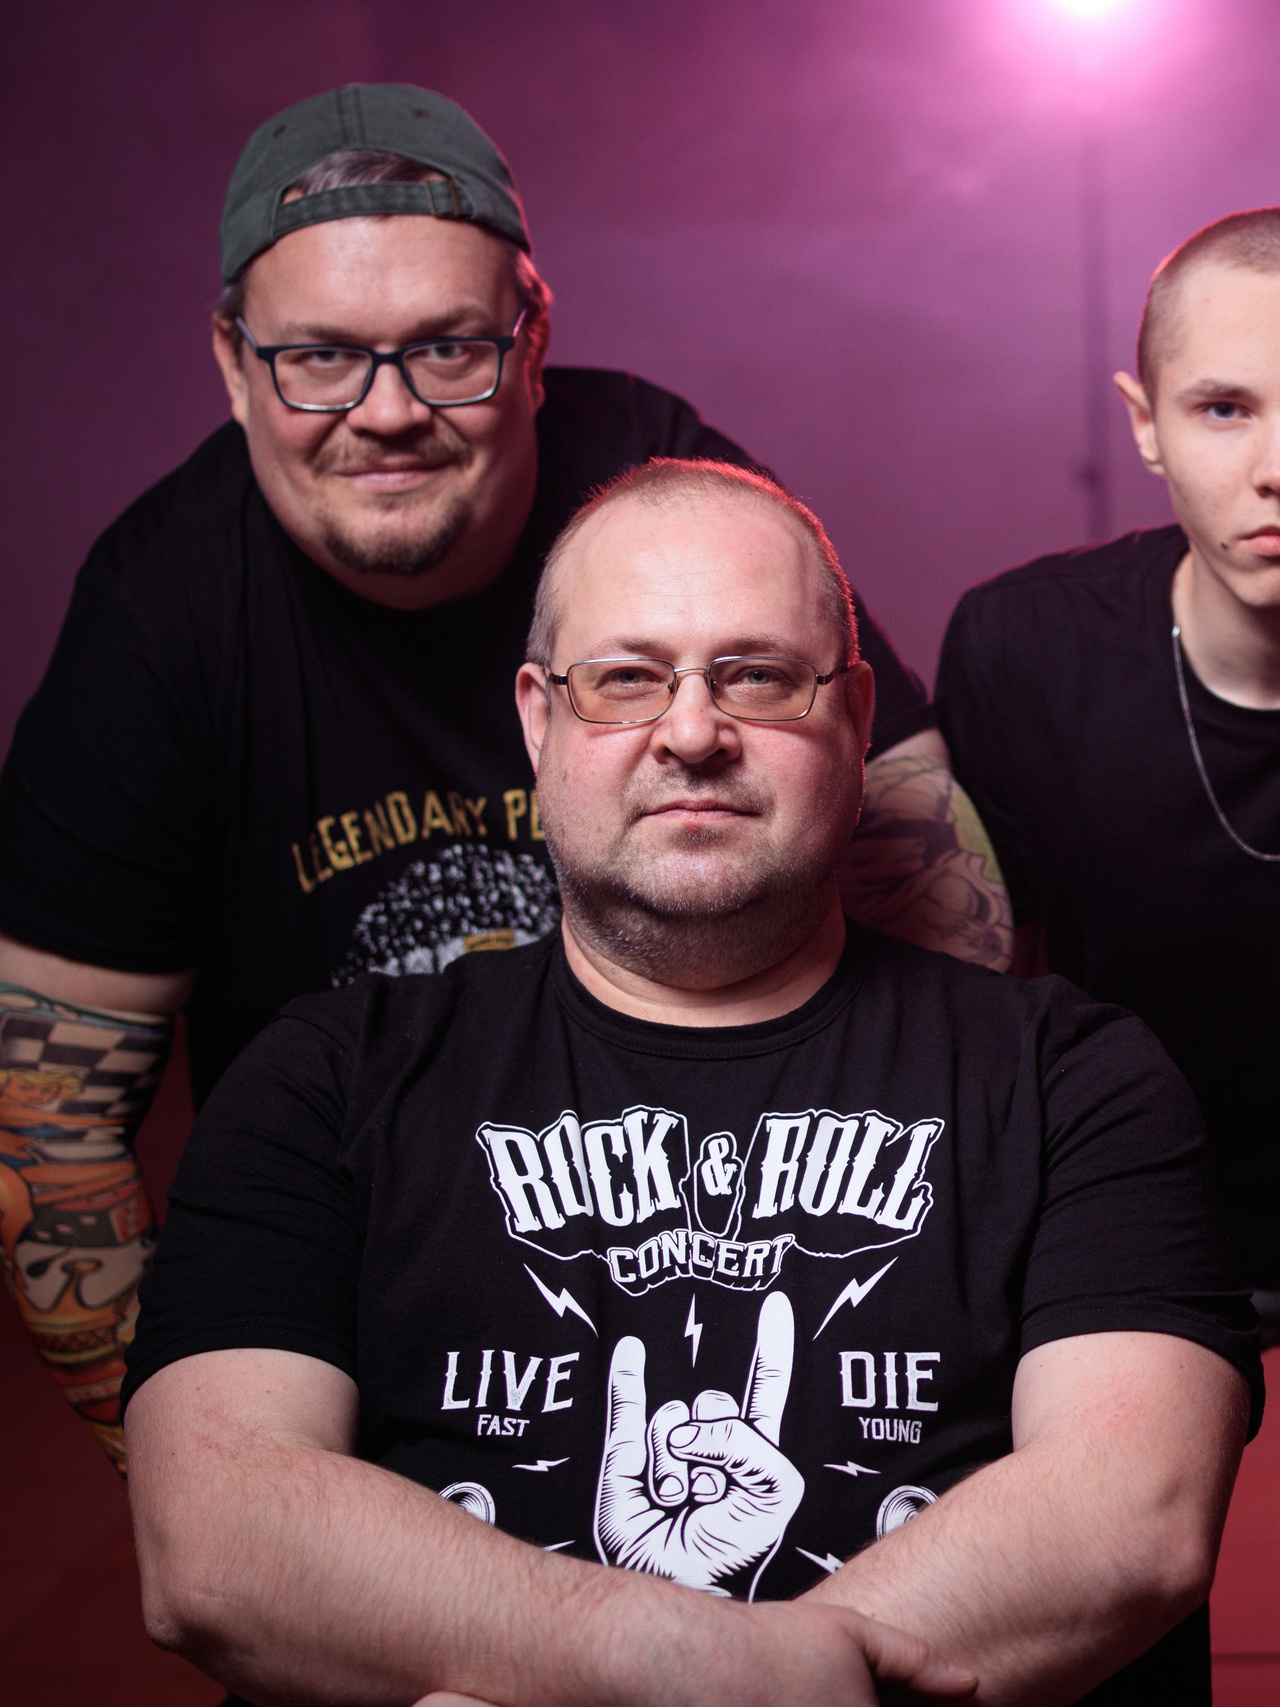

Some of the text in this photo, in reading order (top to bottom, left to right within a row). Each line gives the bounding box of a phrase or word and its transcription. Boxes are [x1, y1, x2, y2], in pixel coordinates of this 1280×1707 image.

[291, 790, 487, 894] LEGENDARY
[482, 1110, 940, 1234] ROCK & ROLL
[609, 1232, 789, 1283] CONCERT
[441, 1350, 580, 1412] LIVE
[839, 1351, 941, 1412] DIE
[477, 1414, 530, 1438] FAST
[858, 1417, 923, 1444] YOUNG
